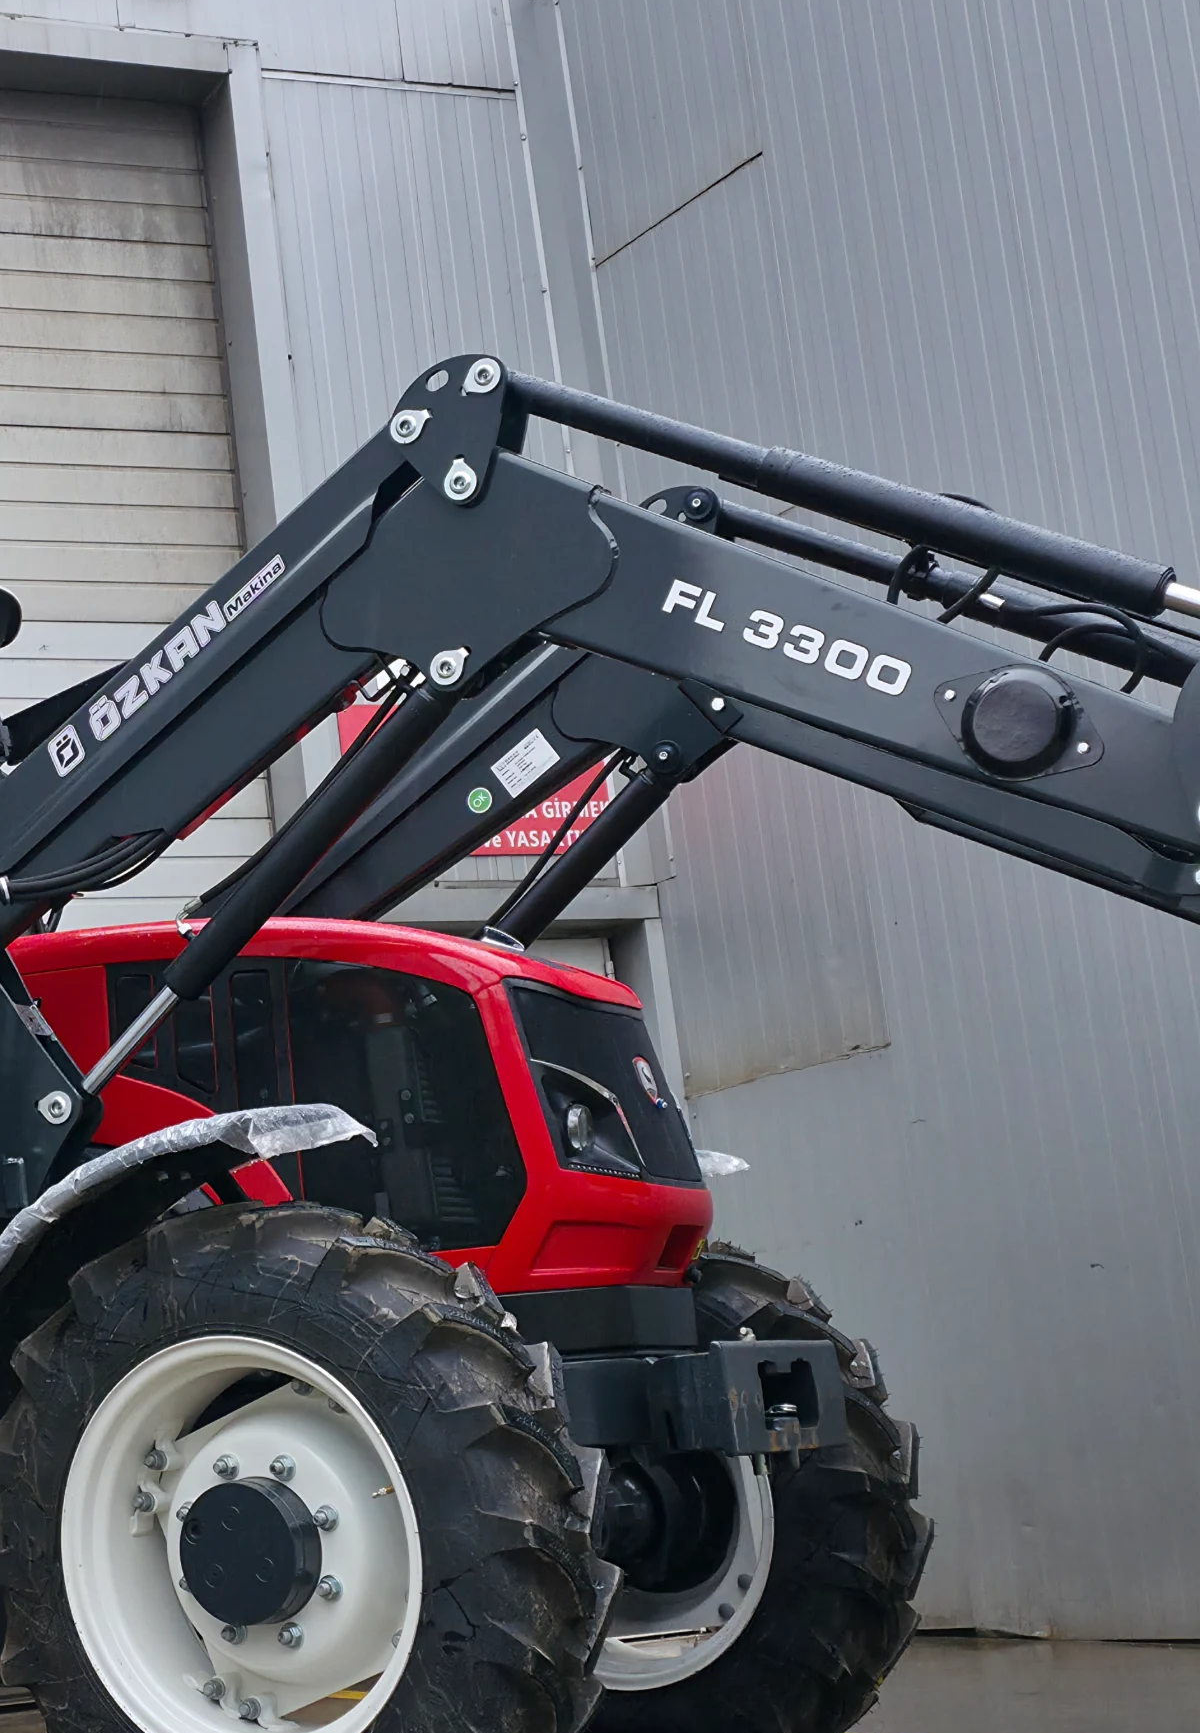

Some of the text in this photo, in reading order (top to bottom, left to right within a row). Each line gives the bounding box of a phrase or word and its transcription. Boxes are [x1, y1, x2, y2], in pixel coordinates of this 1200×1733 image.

[226, 562, 282, 617] Makina
[89, 600, 227, 741] ÖZKAN
[661, 579, 912, 696] FL 3300
[473, 792, 488, 808] OK
